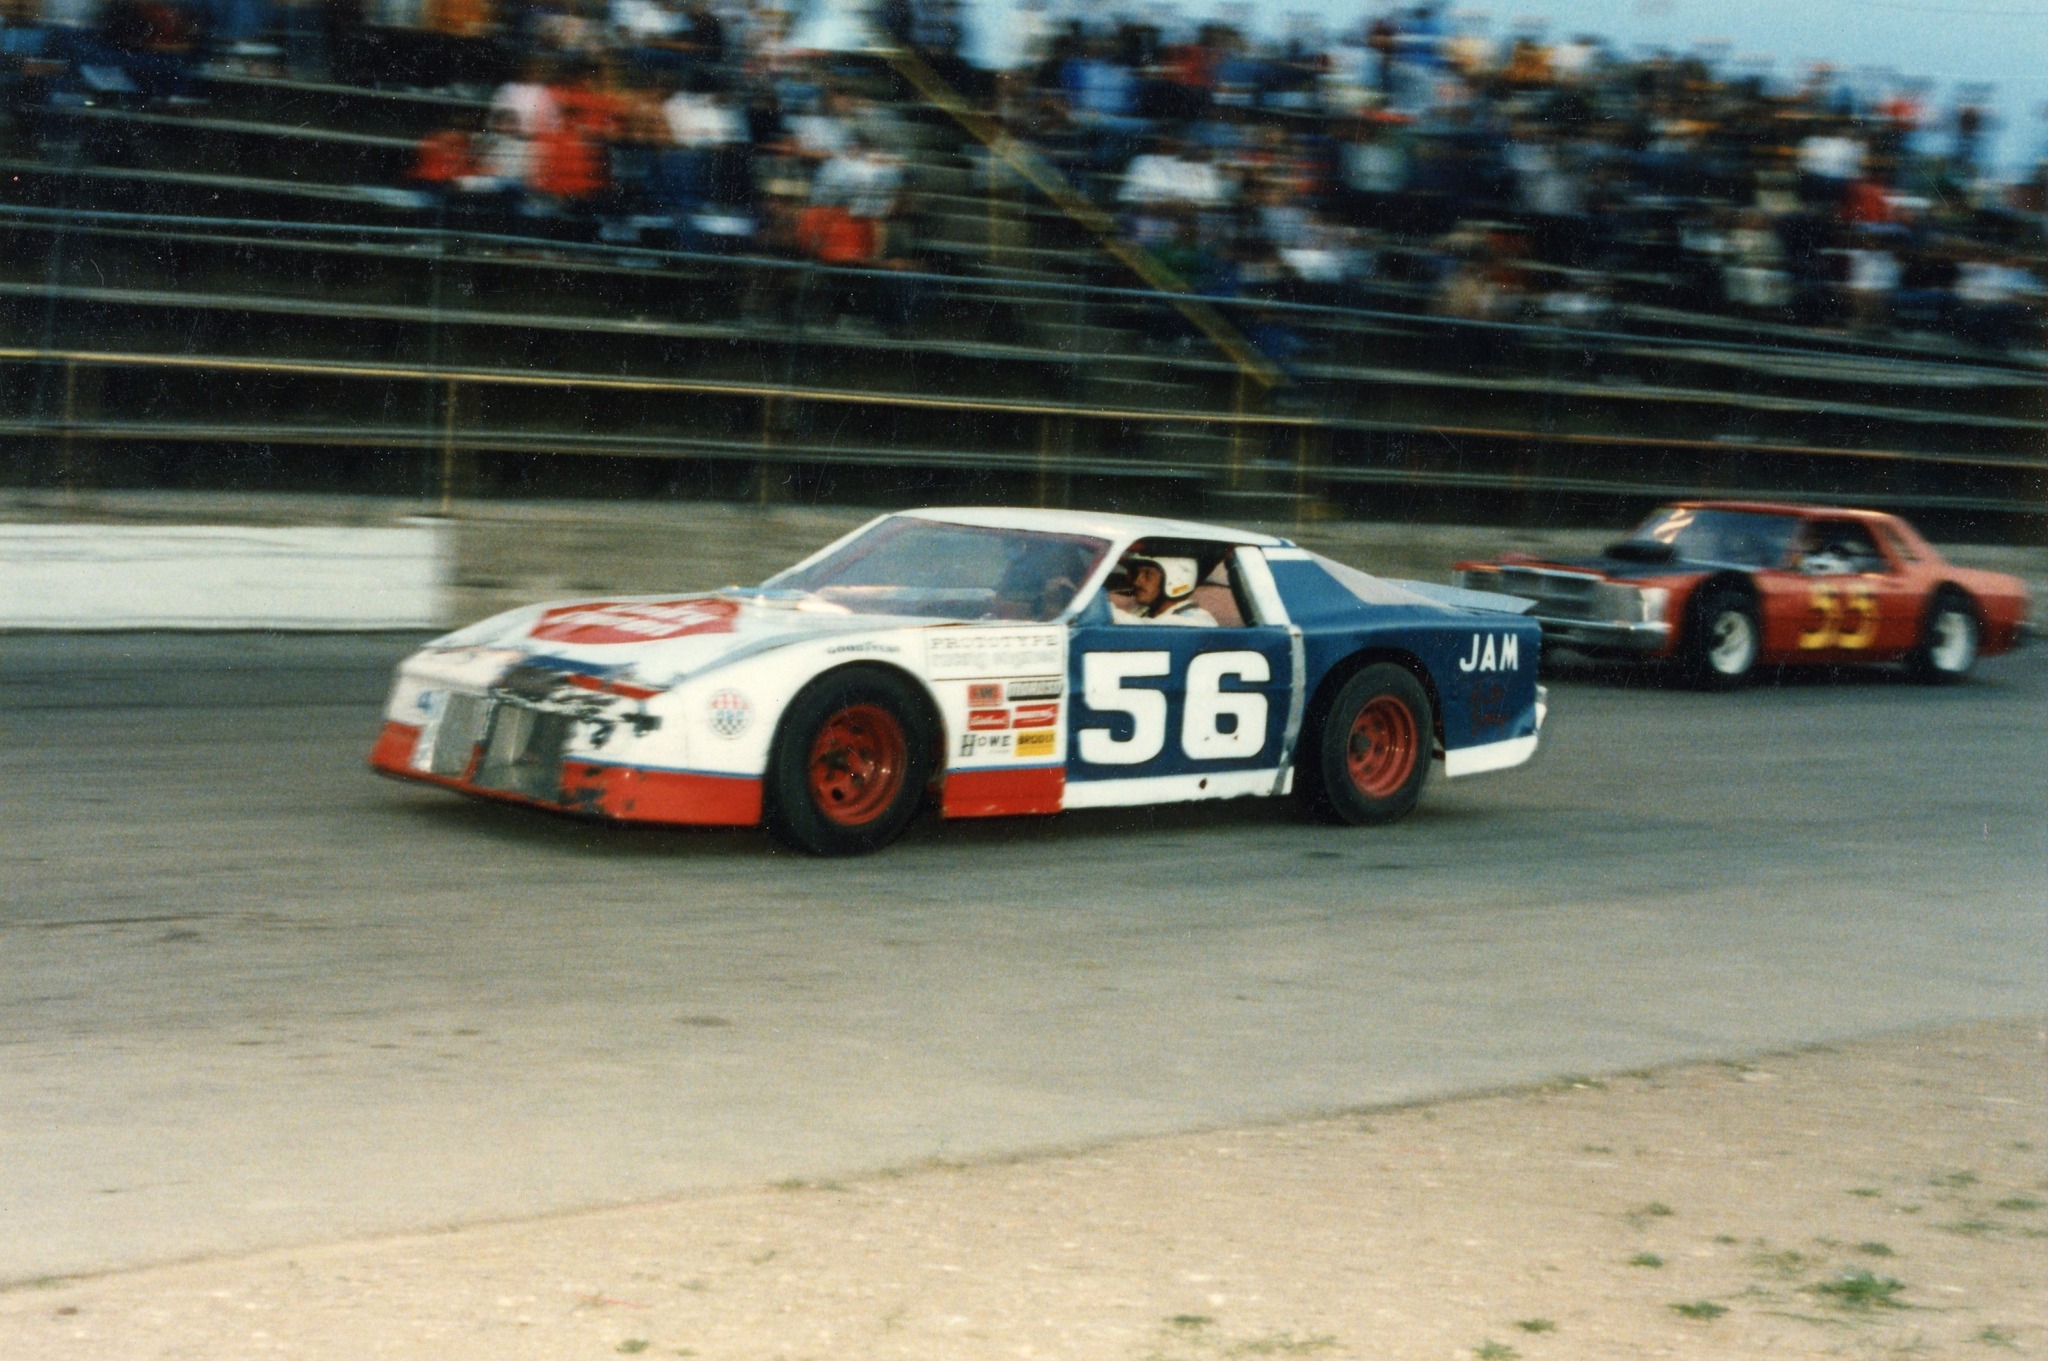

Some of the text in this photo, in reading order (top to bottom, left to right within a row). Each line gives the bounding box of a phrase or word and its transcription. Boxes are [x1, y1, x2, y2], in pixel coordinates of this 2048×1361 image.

[1460, 633, 1518, 672] JAM
[1078, 651, 1270, 764] 56
[959, 734, 1011, 757] HOWE
